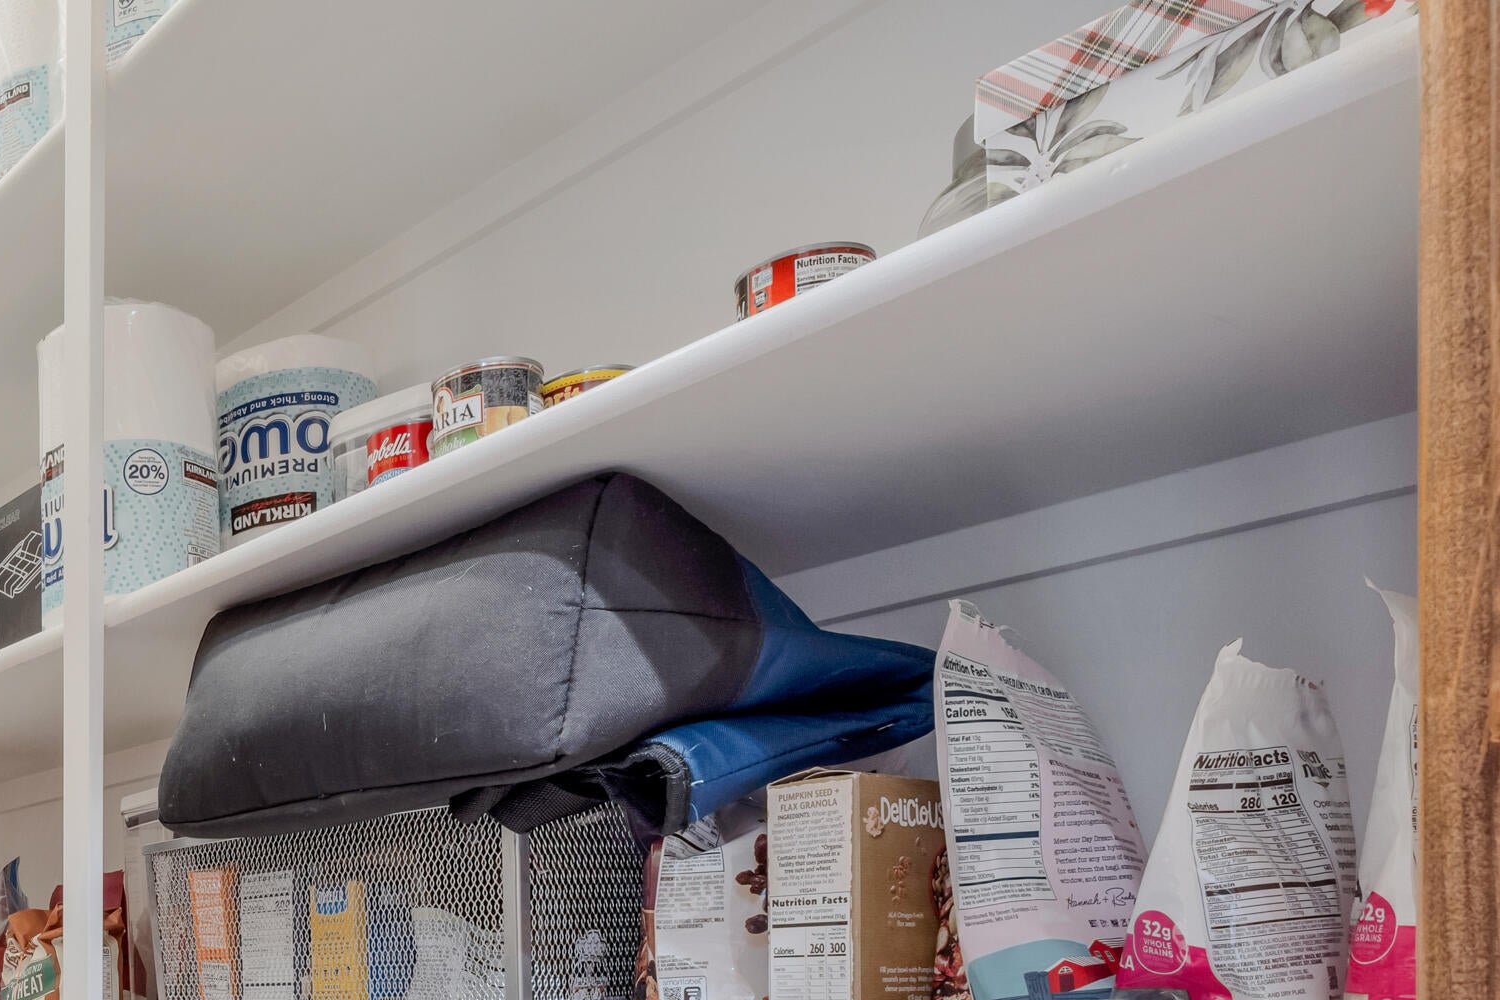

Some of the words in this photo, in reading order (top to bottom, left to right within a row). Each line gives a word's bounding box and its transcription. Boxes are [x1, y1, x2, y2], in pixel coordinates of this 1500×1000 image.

[796, 255, 836, 269] Nutrition
[838, 254, 858, 264] Facts
[270, 395, 297, 407] Thick
[300, 393, 335, 404] Strong,
[250, 399, 267, 413] and
[433, 403, 475, 435] ARIA
[128, 464, 165, 480] 20%
[185, 462, 217, 478] KIRKLAN
[226, 458, 319, 491] PREMIUM
[233, 501, 313, 531] KIRKLAND
[970, 664, 993, 678] Fact
[945, 707, 988, 720] Calories
[1253, 749, 1290, 767] acts
[949, 765, 981, 773] Cholesterol
[950, 776, 970, 784] Sodium
[777, 791, 813, 803] PUMPKIN
[814, 788, 833, 797] SEED
[966, 785, 998, 793] Carbohydrate
[780, 803, 798, 813] FLAX
[799, 798, 838, 810] GRANOLA
[1271, 793, 1298, 806] 120
[771, 898, 818, 908] Nutrition
[821, 896, 848, 905] Facts
[1141, 918, 1172, 941] 32g
[773, 947, 795, 955] Calories
[809, 943, 825, 954] 260
[829, 942, 846, 954] 300
[1143, 938, 1173, 950] WHOLE
[1142, 946, 1174, 958] GRAINS
